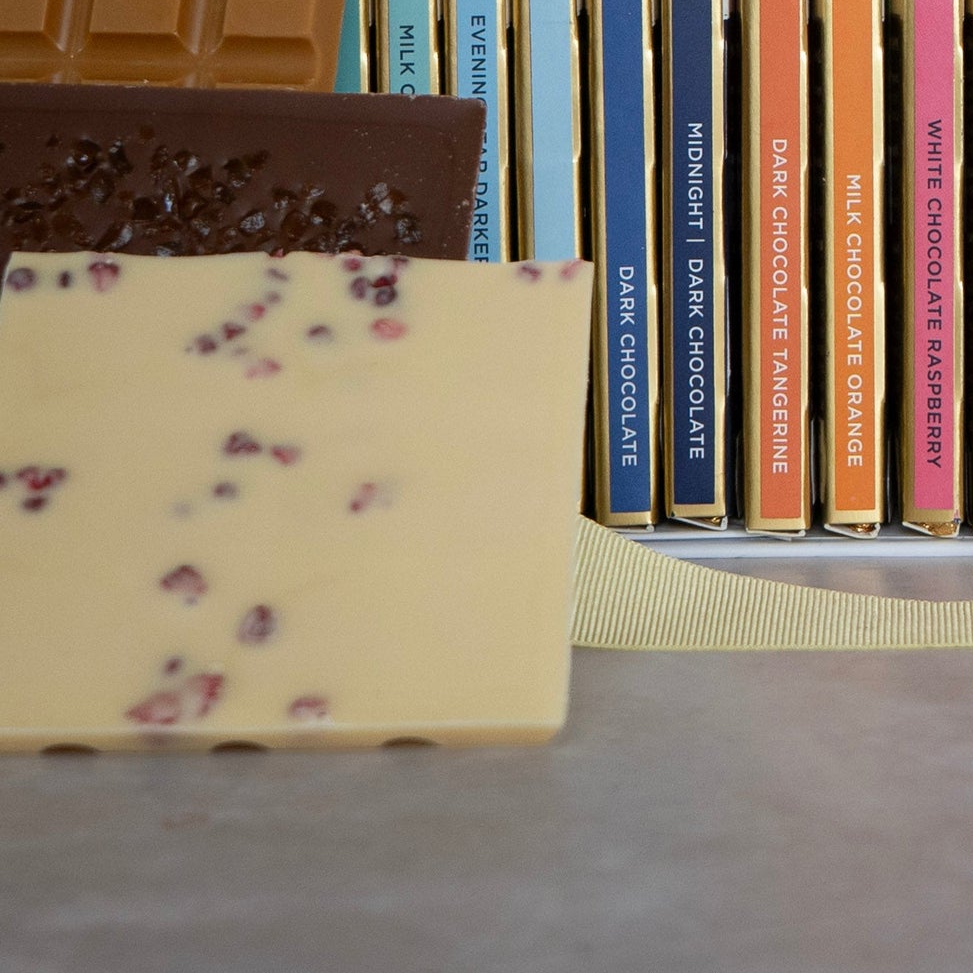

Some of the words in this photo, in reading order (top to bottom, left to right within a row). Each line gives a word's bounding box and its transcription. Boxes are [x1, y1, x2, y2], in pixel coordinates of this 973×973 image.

[398, 24, 416, 76] MILK
[687, 122, 704, 230] MIDNIGHT
[772, 139, 788, 198] DARK
[846, 174, 862, 225] MILK
[927, 119, 943, 190] WHITE
[619, 266, 635, 326] DARK
[688, 259, 704, 318] DARK
[772, 206, 788, 340] CHOCOLATE
[846, 233, 863, 366] CHOCOLATE
[926, 197, 943, 331] CHOCOLATE
[620, 333, 638, 467] CHOCOLATE
[688, 326, 705, 459] CHOCOLATE
[772, 347, 788, 474] TANGERINE
[847, 374, 863, 467] ORANGE
[926, 339, 942, 469] RASPBERRY
